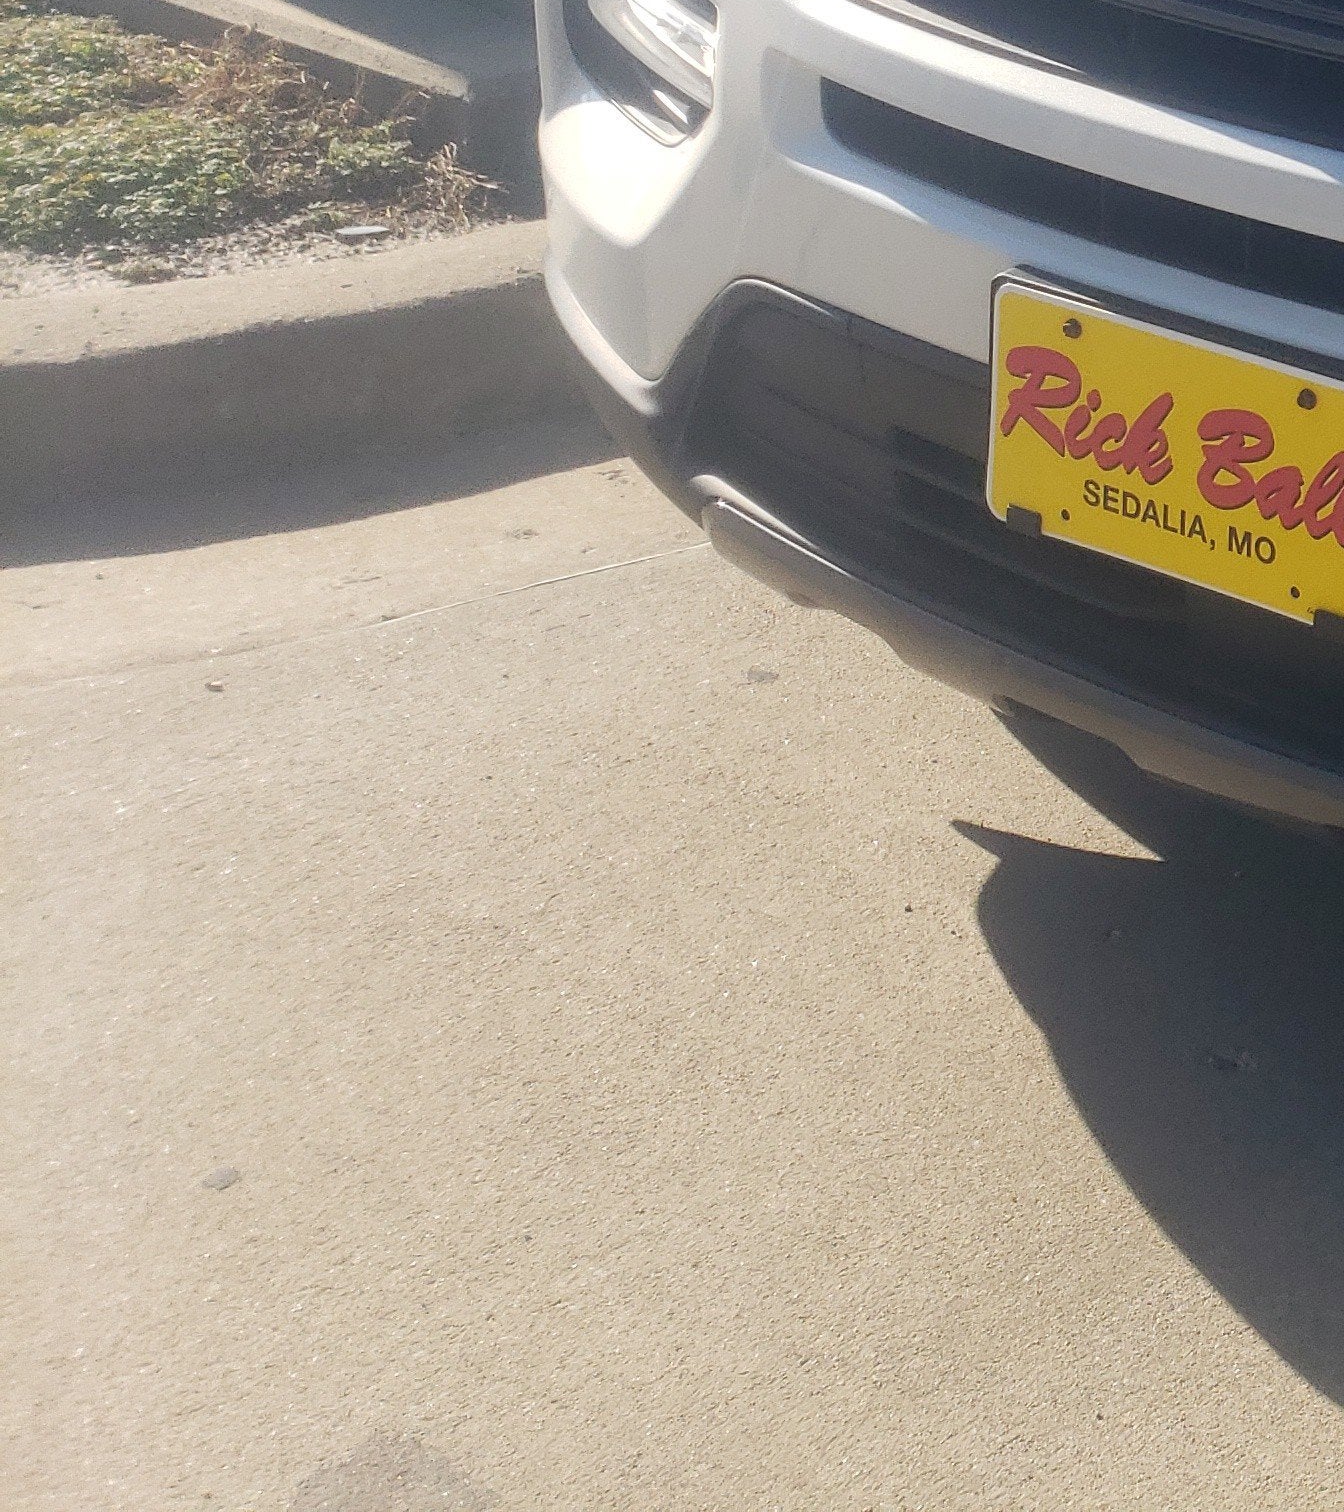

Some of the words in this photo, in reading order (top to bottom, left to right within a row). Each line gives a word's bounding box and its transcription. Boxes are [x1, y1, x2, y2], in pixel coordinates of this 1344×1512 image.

[1000, 346, 1174, 485] Rick
[1083, 478, 1216, 551] SEDALIA,
[1228, 525, 1277, 564] MO
